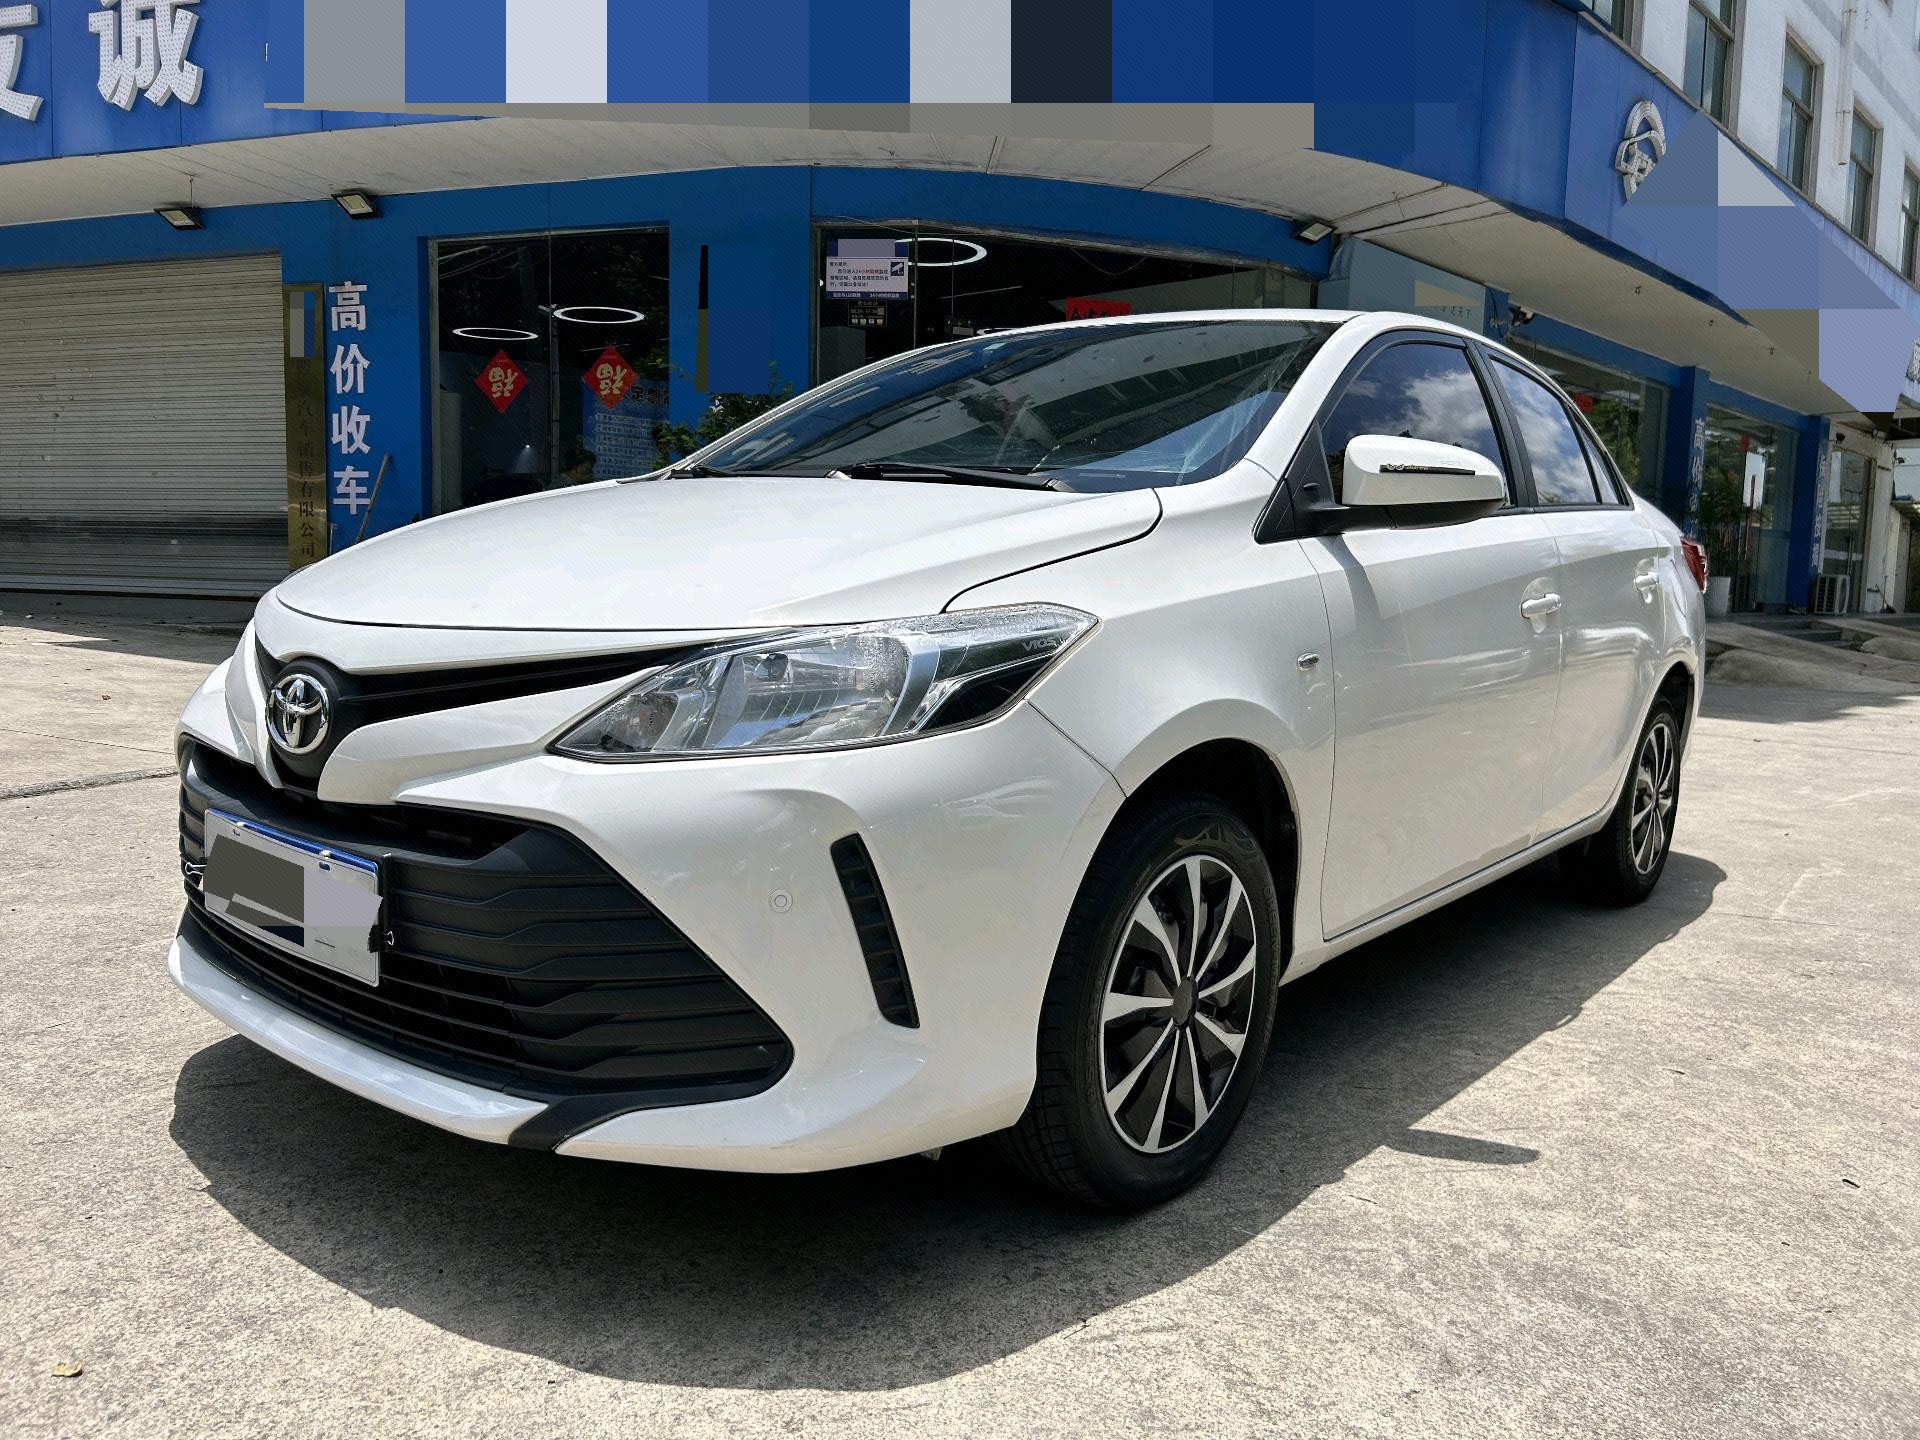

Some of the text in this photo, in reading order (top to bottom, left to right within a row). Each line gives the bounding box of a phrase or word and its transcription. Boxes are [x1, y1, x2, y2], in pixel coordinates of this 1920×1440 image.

[329, 281, 371, 515] 高价收车
[1020, 636, 1057, 651] VIOS
